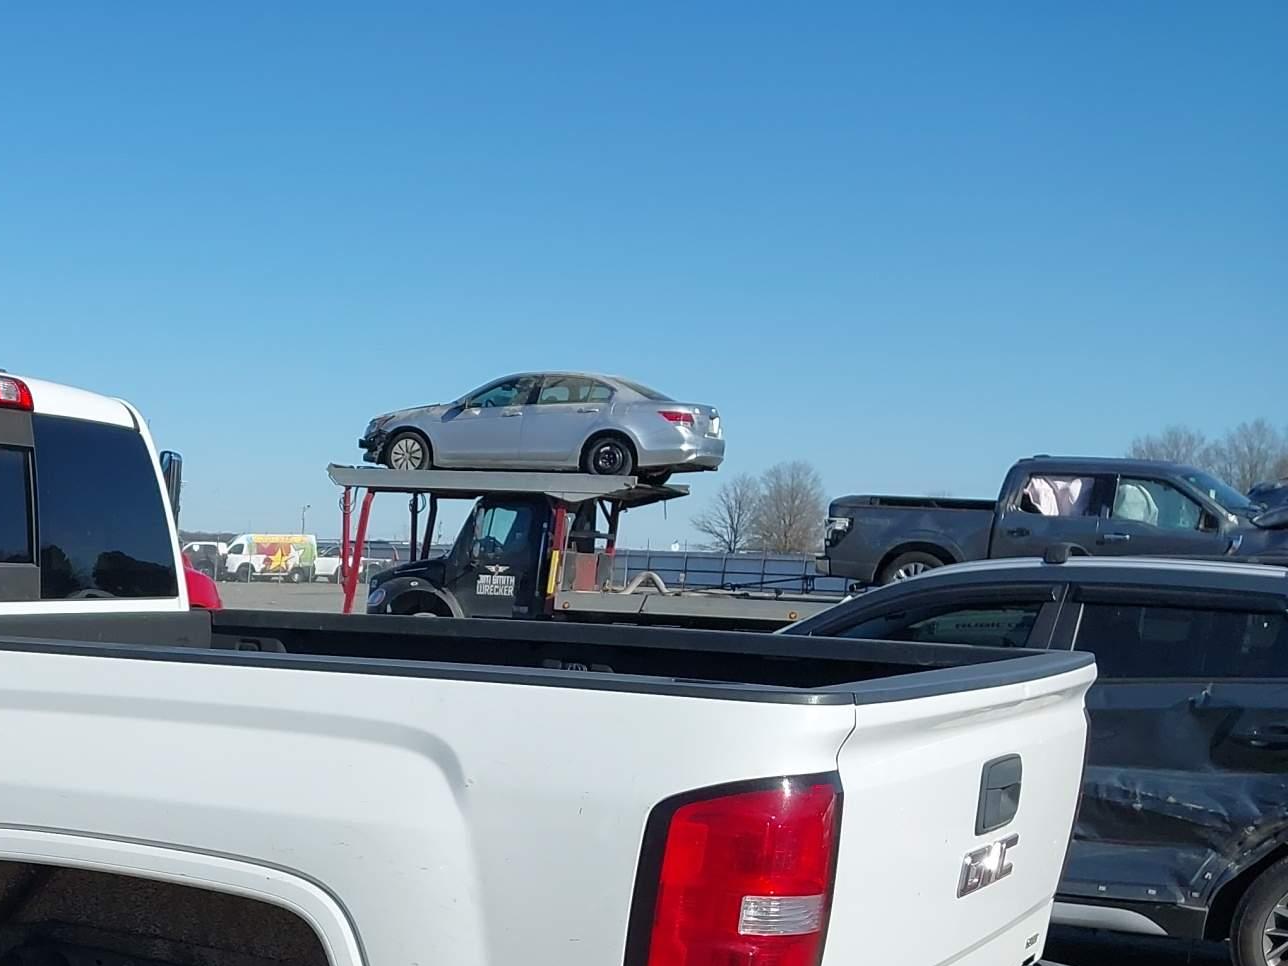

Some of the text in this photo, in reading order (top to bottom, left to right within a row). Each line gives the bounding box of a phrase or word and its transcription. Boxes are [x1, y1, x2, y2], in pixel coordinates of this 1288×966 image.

[477, 574, 515, 585] JIM SMITH
[476, 584, 514, 596] WRECKER
